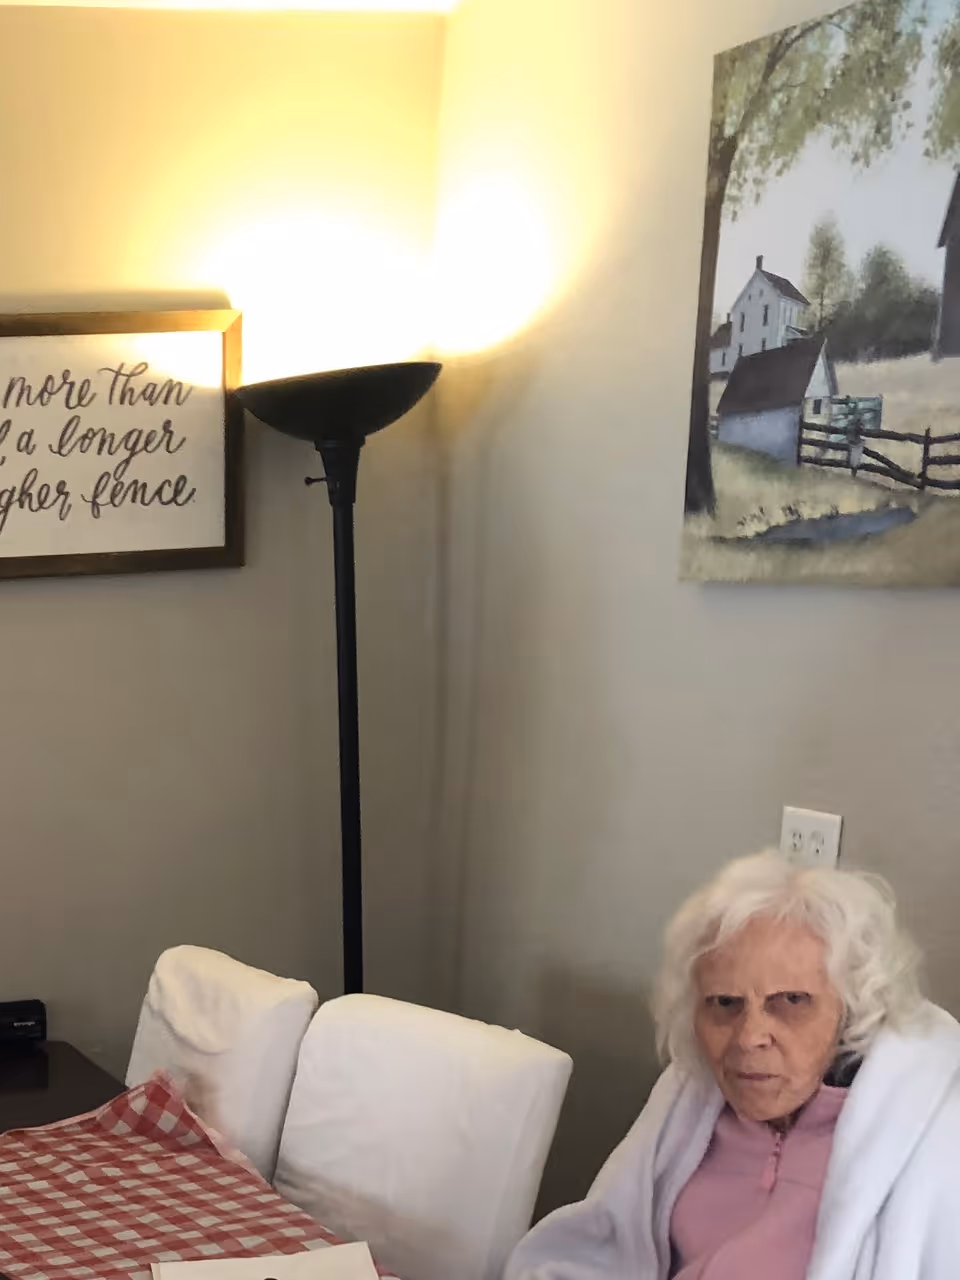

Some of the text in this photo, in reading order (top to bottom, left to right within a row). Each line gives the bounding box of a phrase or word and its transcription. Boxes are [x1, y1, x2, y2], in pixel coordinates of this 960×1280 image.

[3, 369, 97, 410] more
[97, 362, 193, 406] than
[16, 428, 37, 456] a
[48, 415, 187, 481] longer
